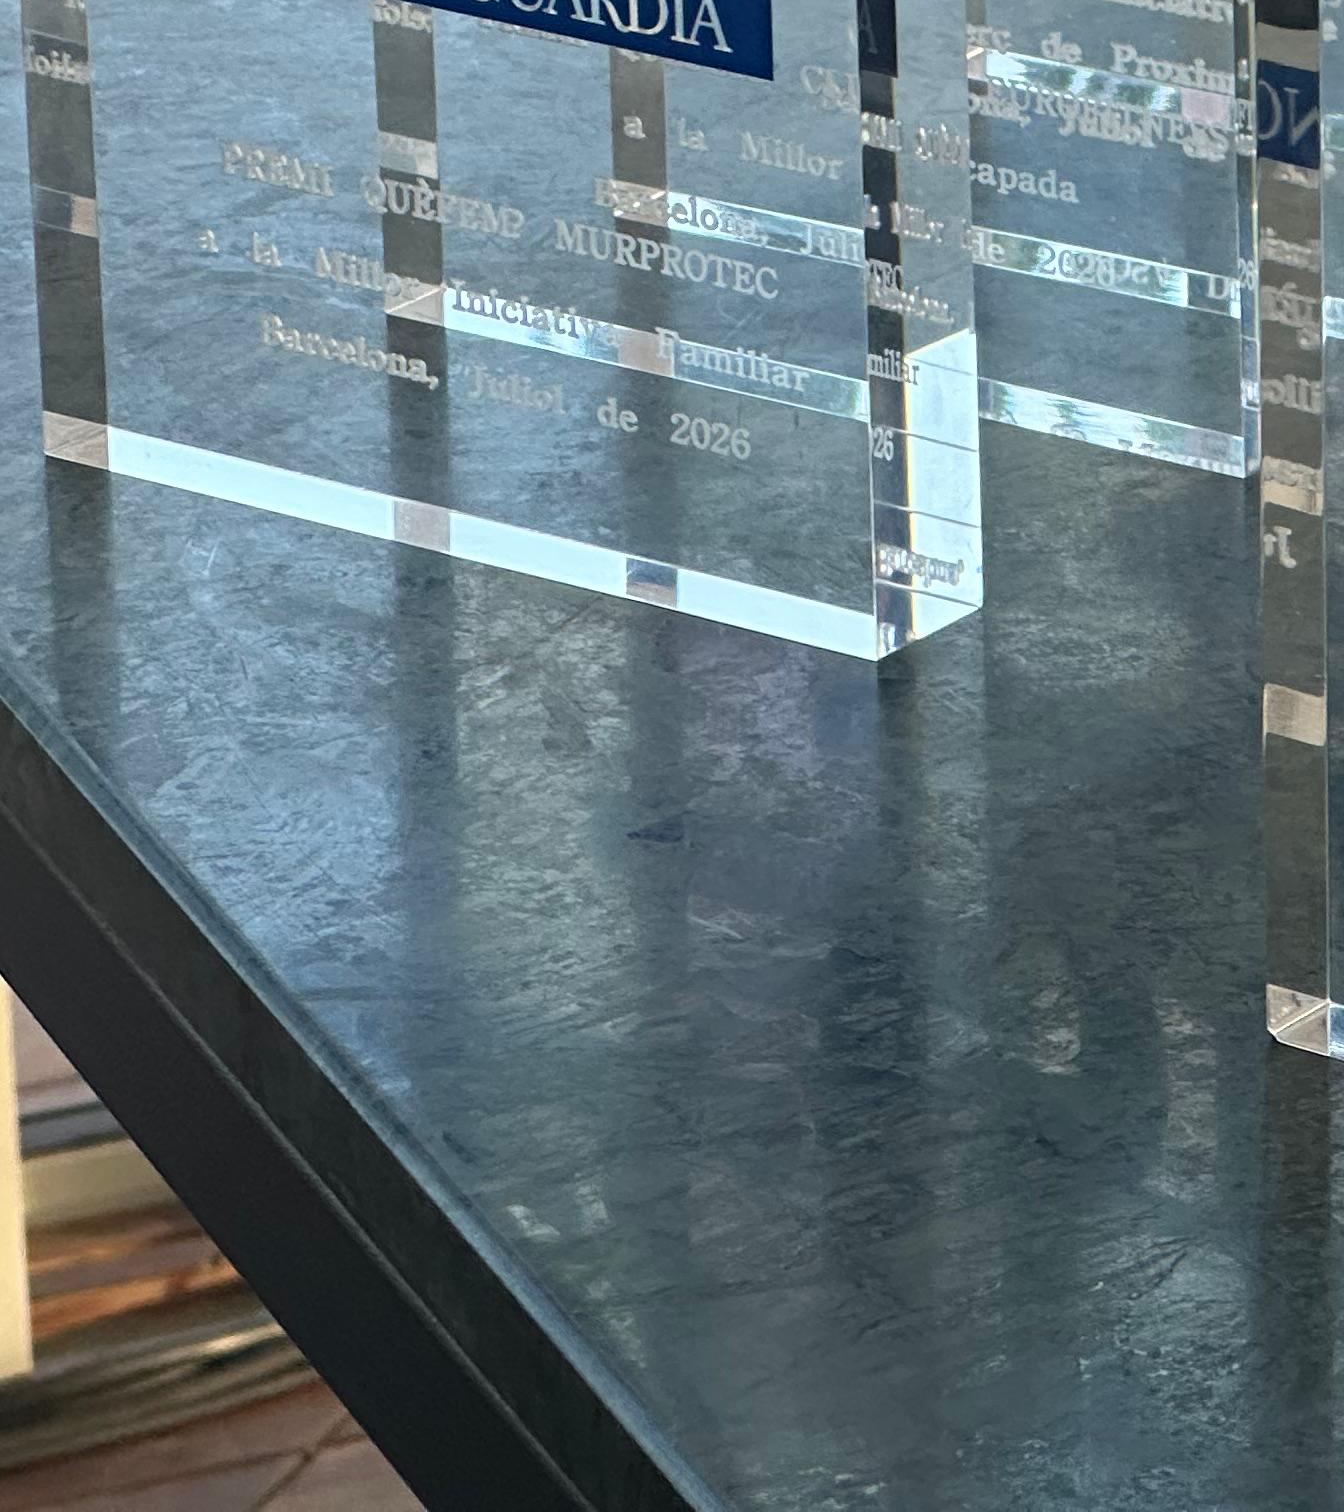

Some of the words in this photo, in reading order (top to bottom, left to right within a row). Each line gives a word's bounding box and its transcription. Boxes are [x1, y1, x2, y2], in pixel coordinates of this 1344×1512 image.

[623, 116, 647, 140] a
[740, 132, 845, 182] Millor
[552, 218, 780, 300] MURPROTEC
[799, 226, 865, 264] Juli
[451, 279, 621, 348] Iniciativa
[654, 326, 811, 393] Familiar
[260, 311, 439, 392] Barcelona,
[595, 398, 640, 433] de
[669, 412, 753, 461] 2026
